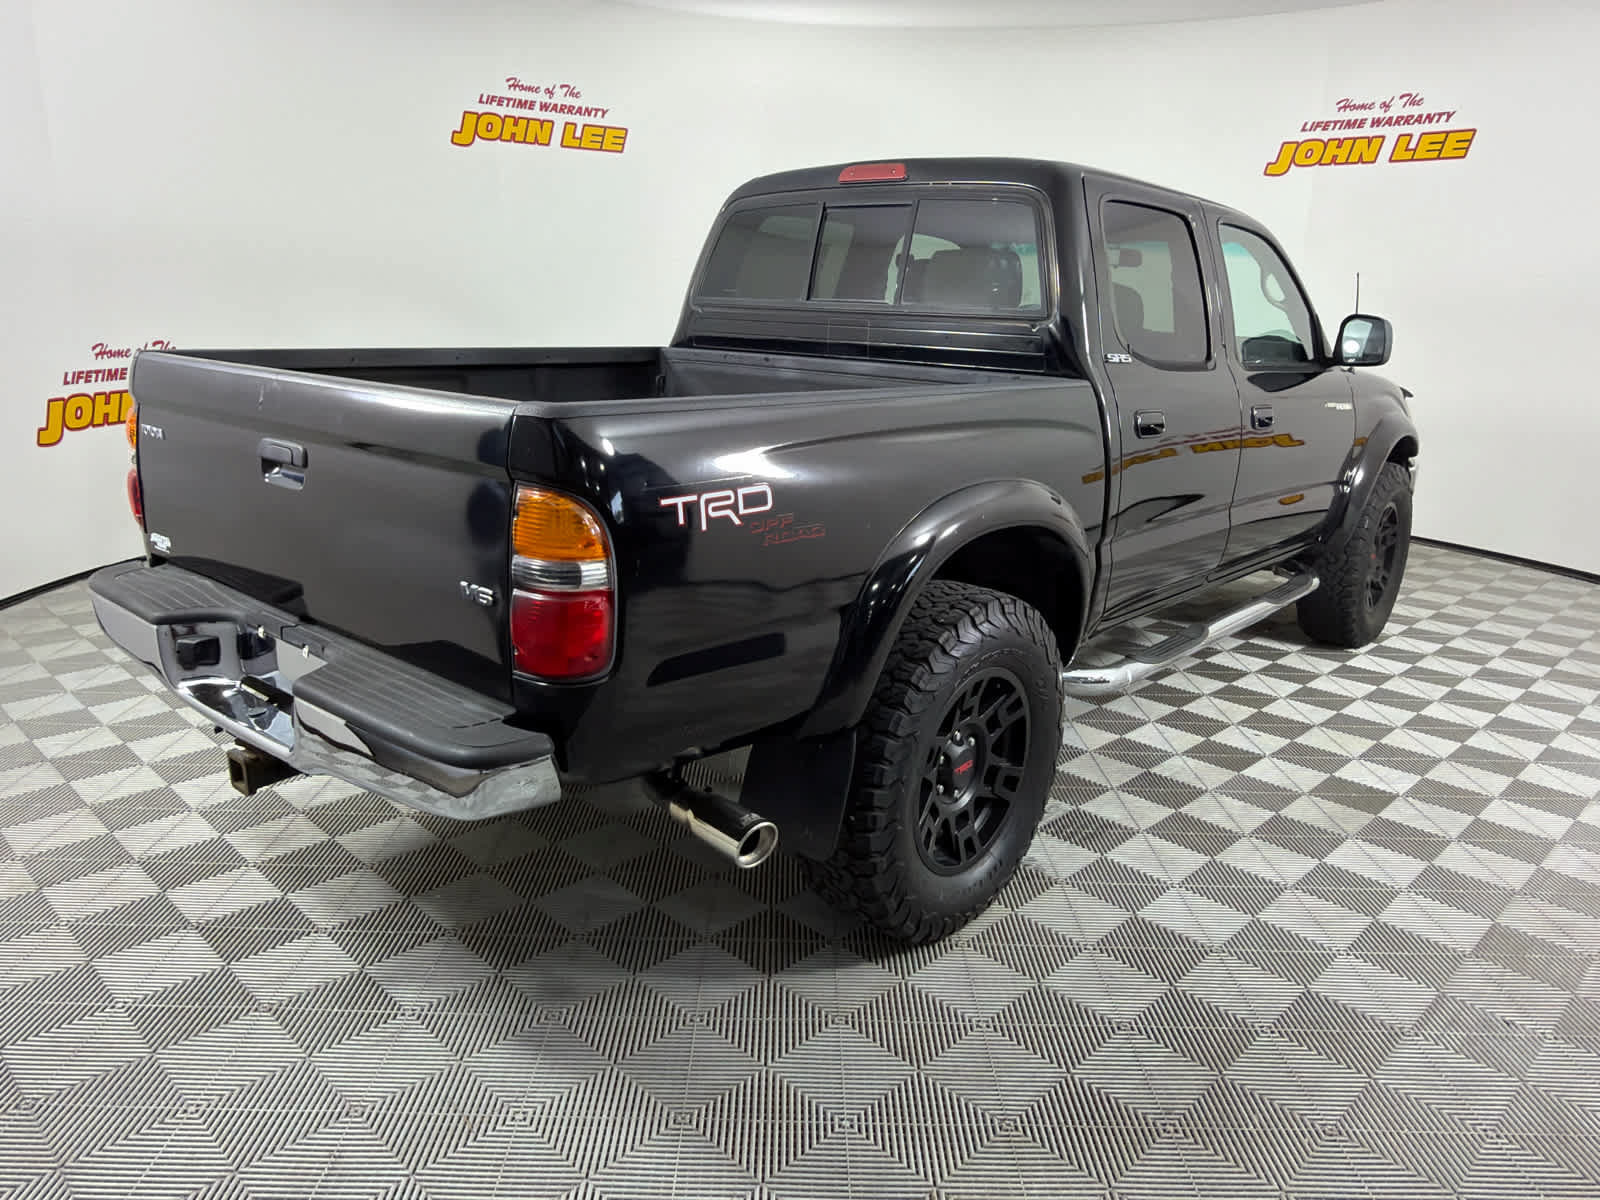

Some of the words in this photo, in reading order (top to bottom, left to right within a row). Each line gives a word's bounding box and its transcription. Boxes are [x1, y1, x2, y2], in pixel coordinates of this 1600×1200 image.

[505, 77, 541, 95] Home
[544, 84, 556, 99] of
[559, 84, 582, 99] The
[478, 93, 536, 111] LIFETIME
[539, 101, 609, 119] WARRANTY
[1336, 98, 1375, 113] Home
[1379, 96, 1395, 113] of
[1399, 93, 1424, 107] The
[451, 111, 554, 147] JOHN
[560, 122, 628, 153] LEE
[1300, 118, 1366, 132] LIFETIME
[1369, 111, 1456, 128] WARRANTY
[1264, 135, 1386, 177] JOHN
[1388, 128, 1477, 163] LEE
[91, 343, 131, 360] Home
[63, 367, 128, 385] LIFETIME
[660, 482, 773, 532] TRD
[460, 580, 493, 606] V6
